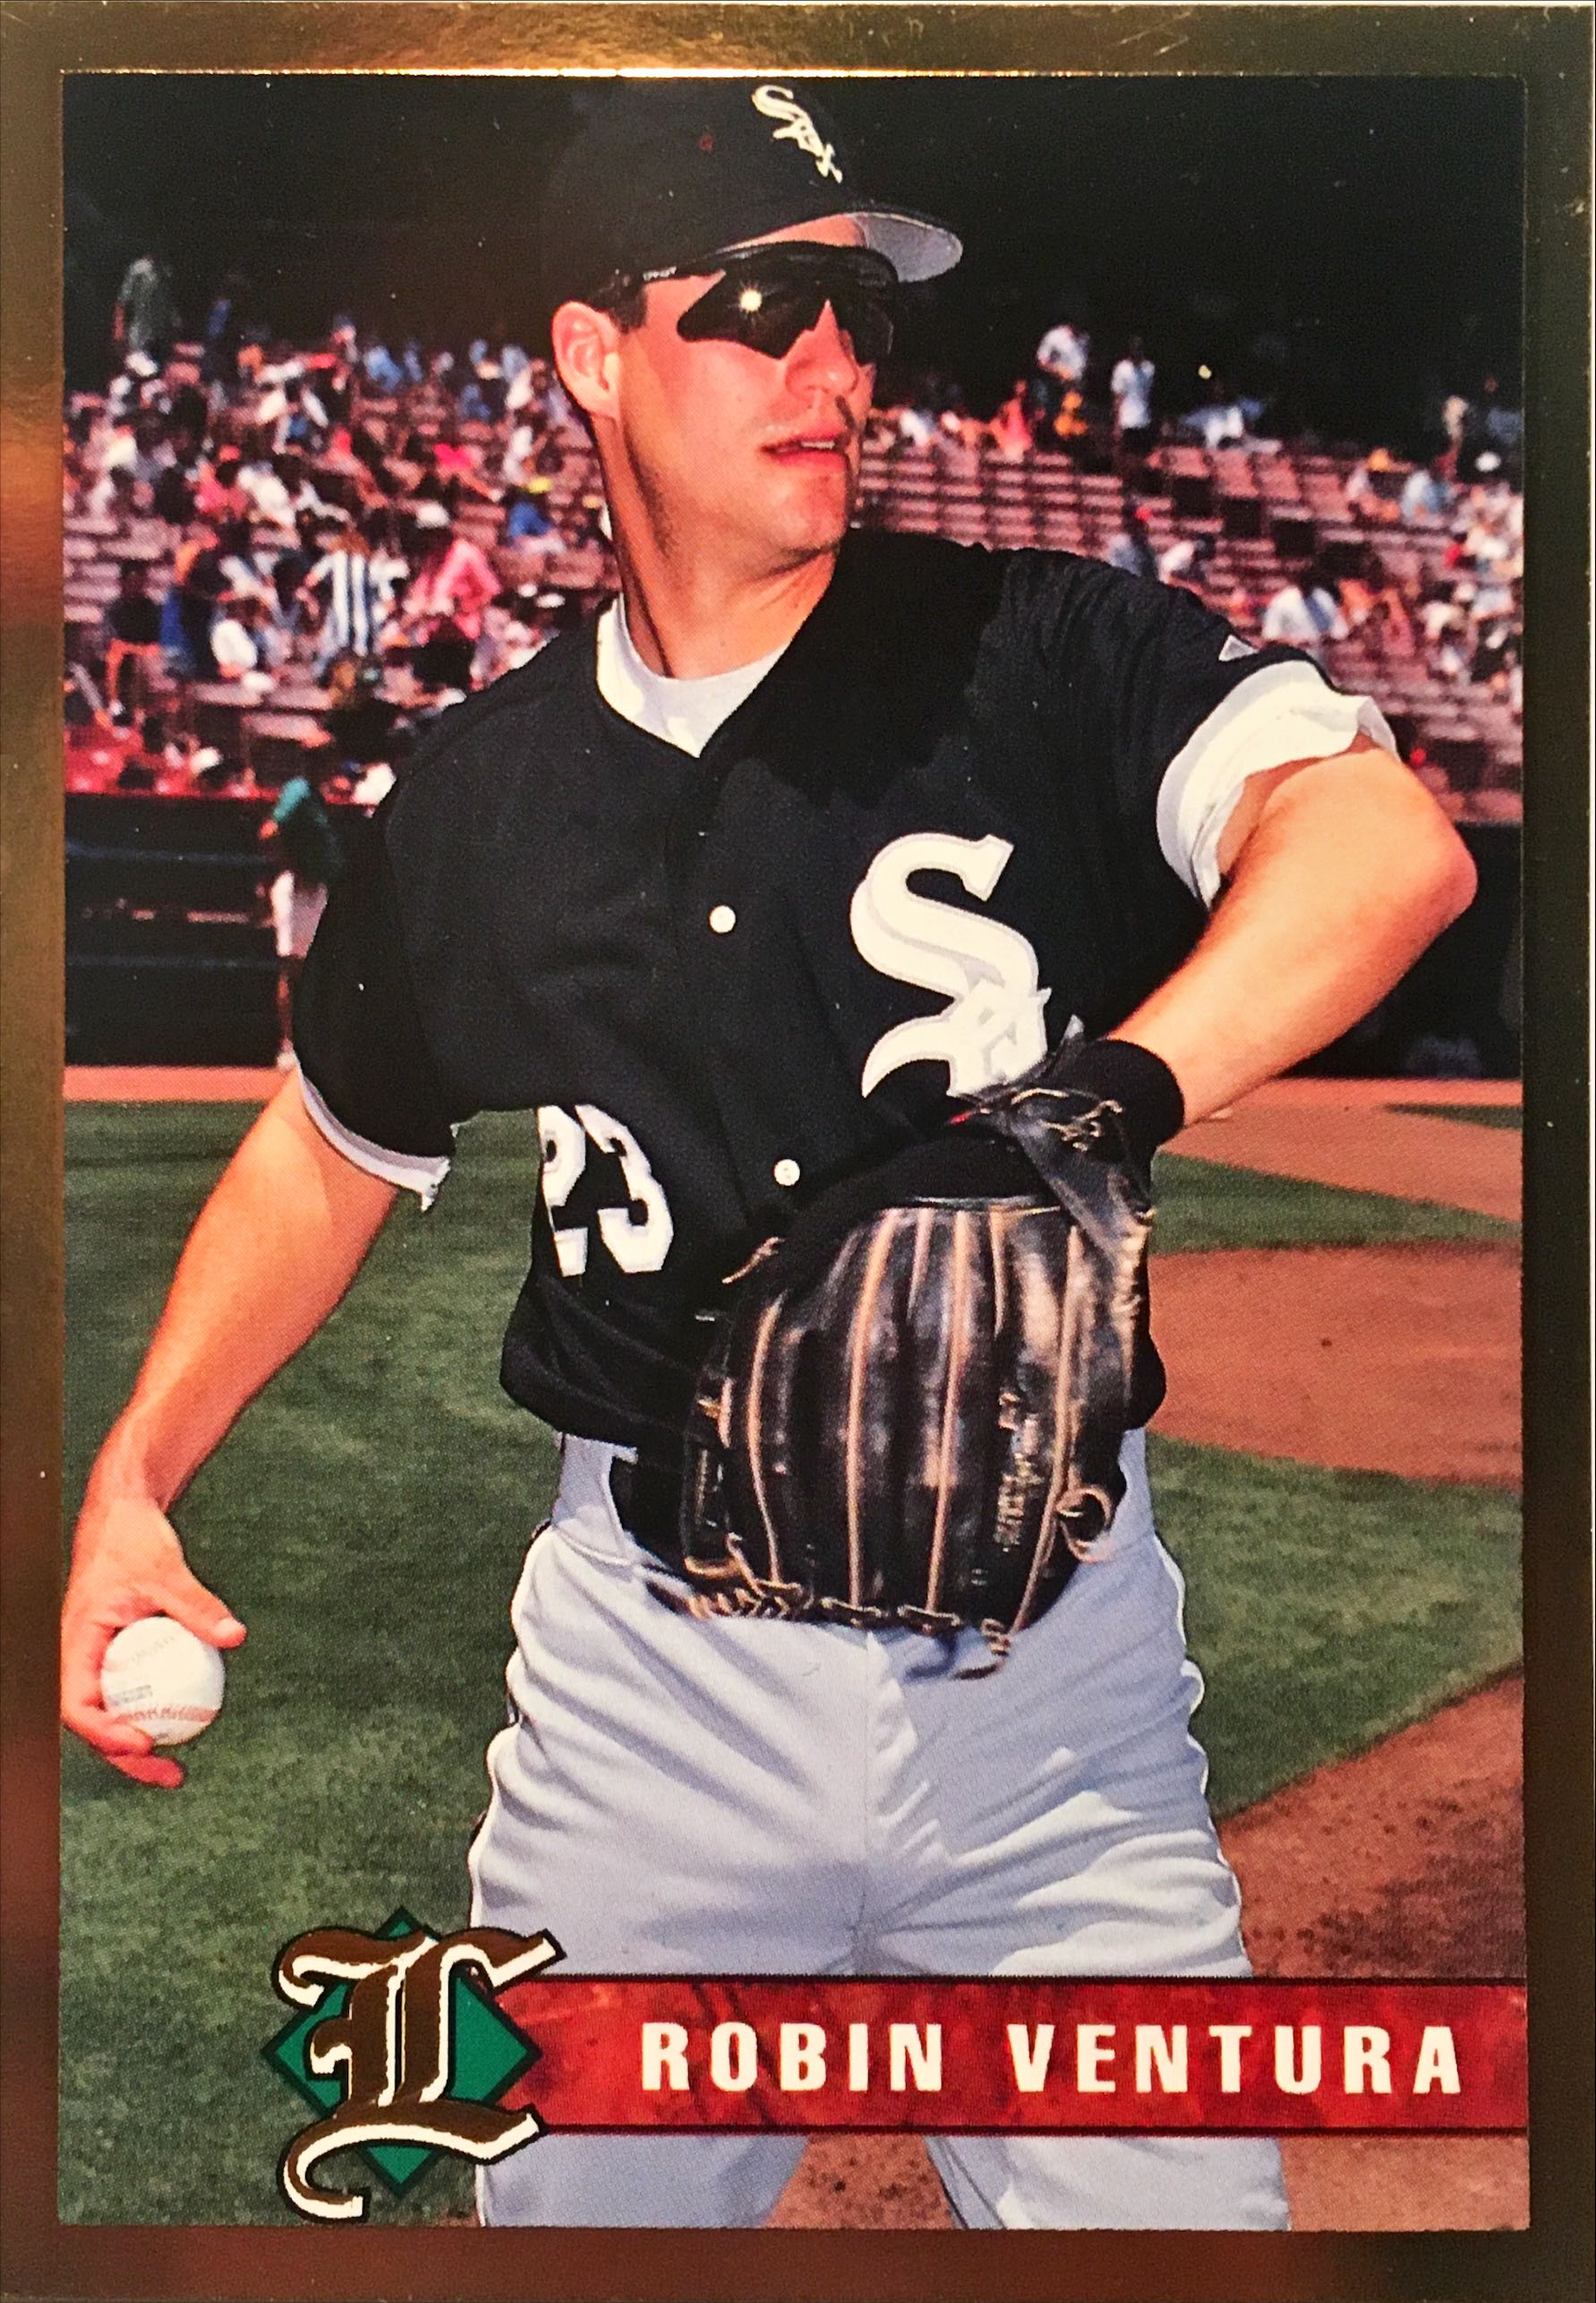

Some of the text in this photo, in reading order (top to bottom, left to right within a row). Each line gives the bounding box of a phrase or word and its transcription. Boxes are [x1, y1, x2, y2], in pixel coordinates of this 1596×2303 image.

[537, 1104, 674, 1277] 23
[642, 2021, 1461, 2094] ROBIN VENTURA
